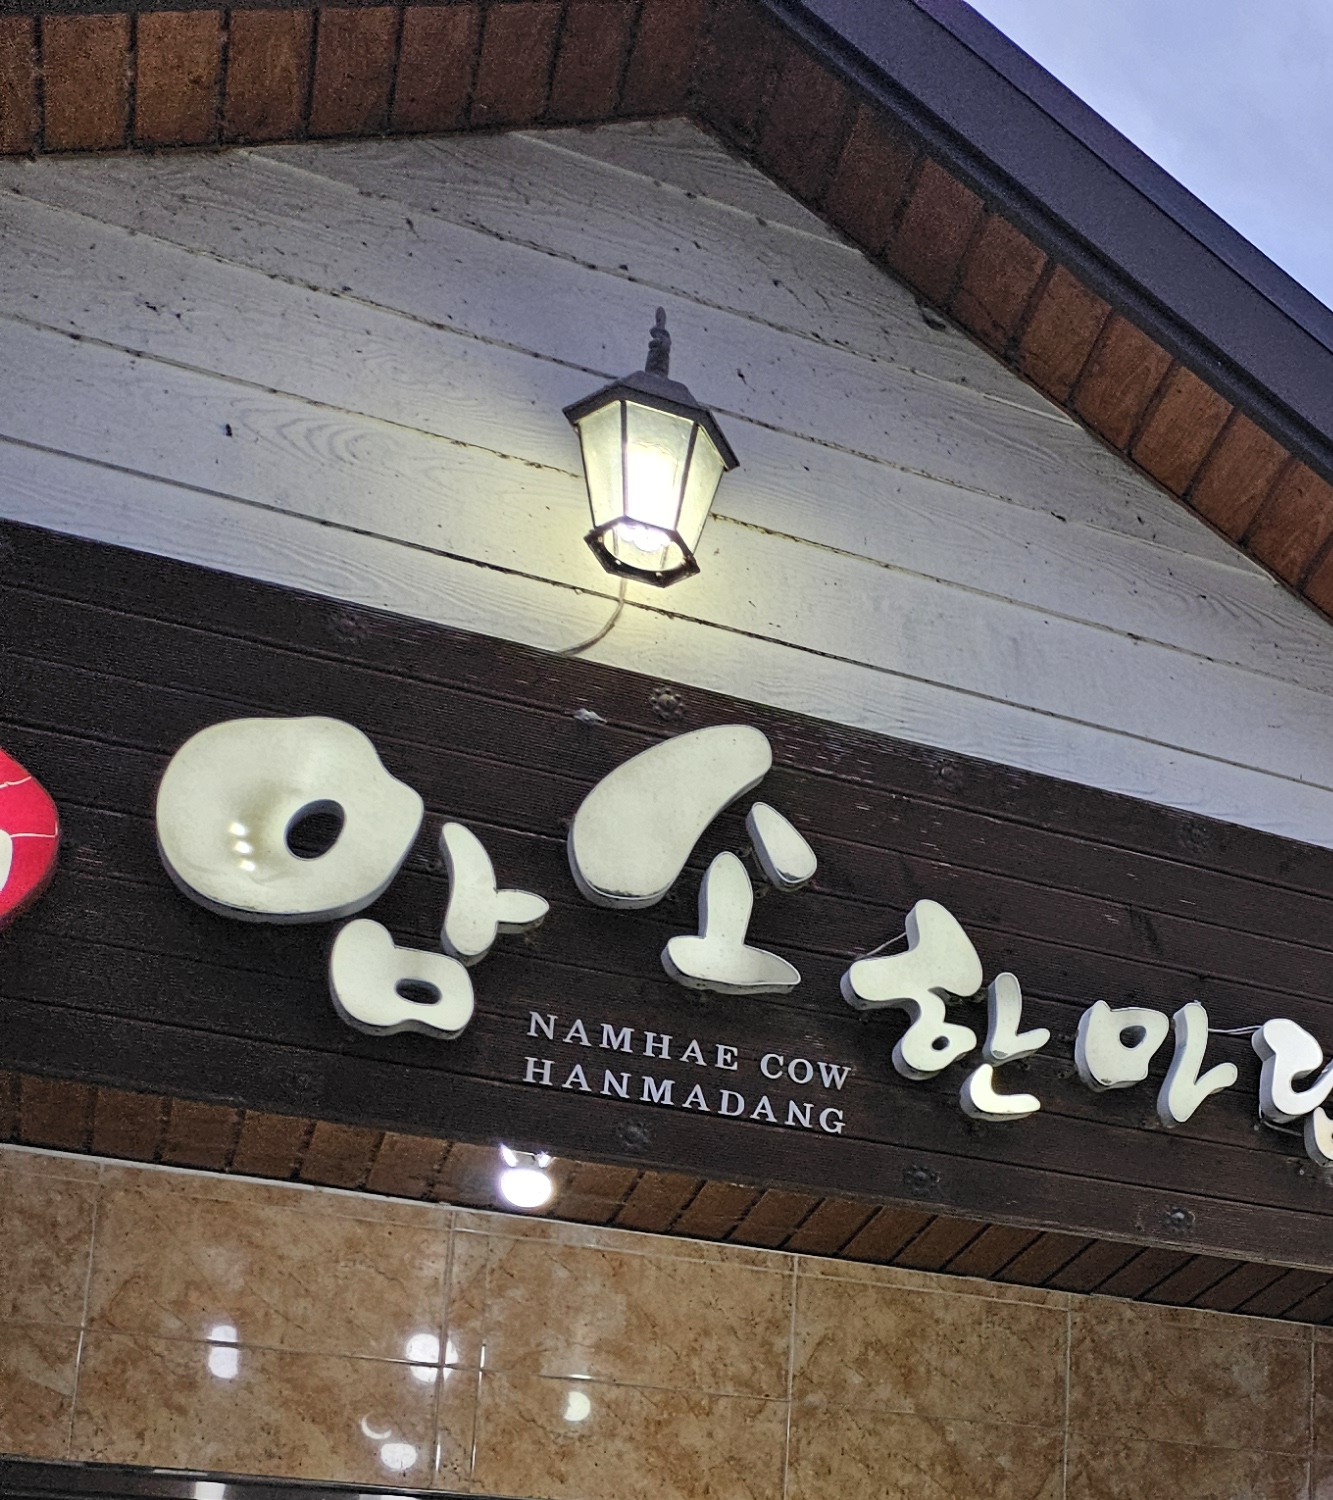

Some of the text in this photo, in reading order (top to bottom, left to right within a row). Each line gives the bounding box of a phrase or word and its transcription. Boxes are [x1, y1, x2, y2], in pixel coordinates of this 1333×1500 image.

[528, 1010, 852, 1091] NAMHAE COW
[523, 1056, 847, 1136] HANMADANG
